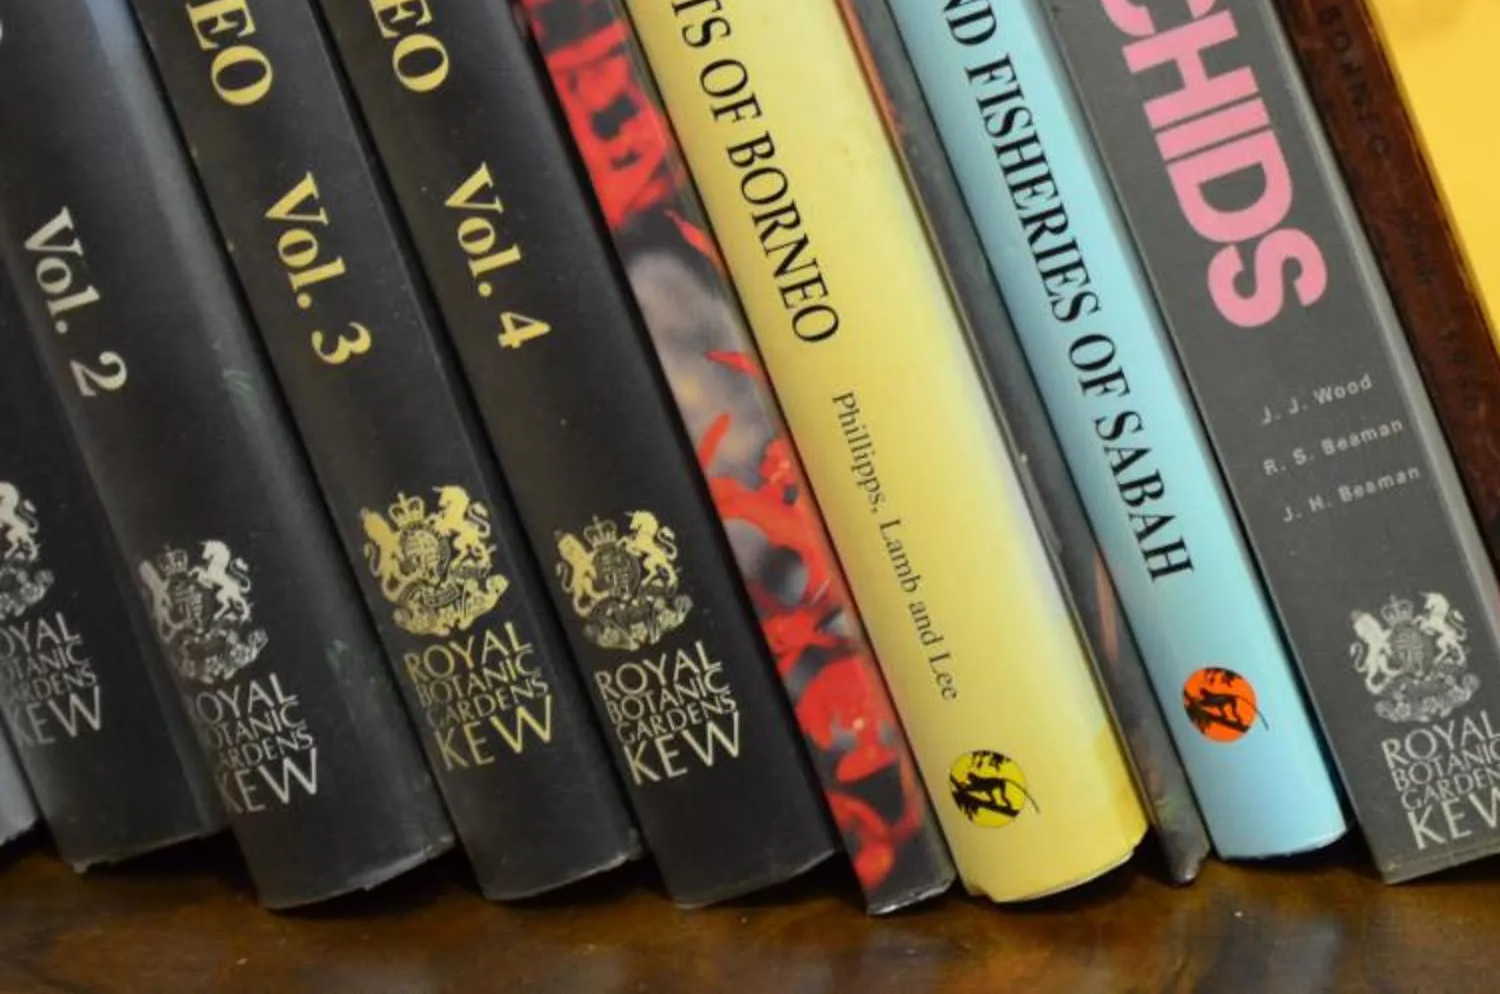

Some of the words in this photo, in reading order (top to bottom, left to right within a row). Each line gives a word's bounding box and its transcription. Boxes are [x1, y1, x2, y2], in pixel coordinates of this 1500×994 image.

[698, 59, 762, 126] OF
[966, 53, 1103, 324] FISHERIES
[444, 162, 522, 298] Vol.
[496, 312, 552, 349] 4
[728, 130, 841, 345] BORNEO
[265, 172, 346, 310] Vol.
[311, 321, 372, 366] 3
[25, 206, 101, 335] Vol.
[70, 350, 128, 398] 2
[1068, 333, 1131, 401] OF
[1261, 407, 1279, 425] J.
[1290, 398, 1308, 415] J.
[1313, 374, 1373, 405] Wood
[832, 391, 886, 514] Phillipps,
[1263, 457, 1286, 476] R.
[1293, 449, 1315, 467] S.
[1321, 419, 1404, 456] Beaman
[1096, 412, 1194, 583] SABAH
[1283, 506, 1302, 523] J.
[1308, 494, 1332, 512] H.
[1338, 466, 1421, 503] Beaman
[880, 518, 920, 596] Lamb
[404, 621, 533, 682] ROYAL
[909, 600, 940, 646] and
[190, 673, 298, 726] OYAL
[415, 651, 541, 708] BOTANIC
[595, 641, 720, 700] ROYAL
[607, 666, 731, 724] BOTANIC
[927, 649, 959, 701] Lee
[426, 677, 548, 728] GARDENS
[433, 694, 551, 769] KEW
[615, 693, 737, 746] GARDENS
[624, 710, 738, 785] KEW
[1381, 710, 1500, 771] ROYAL
